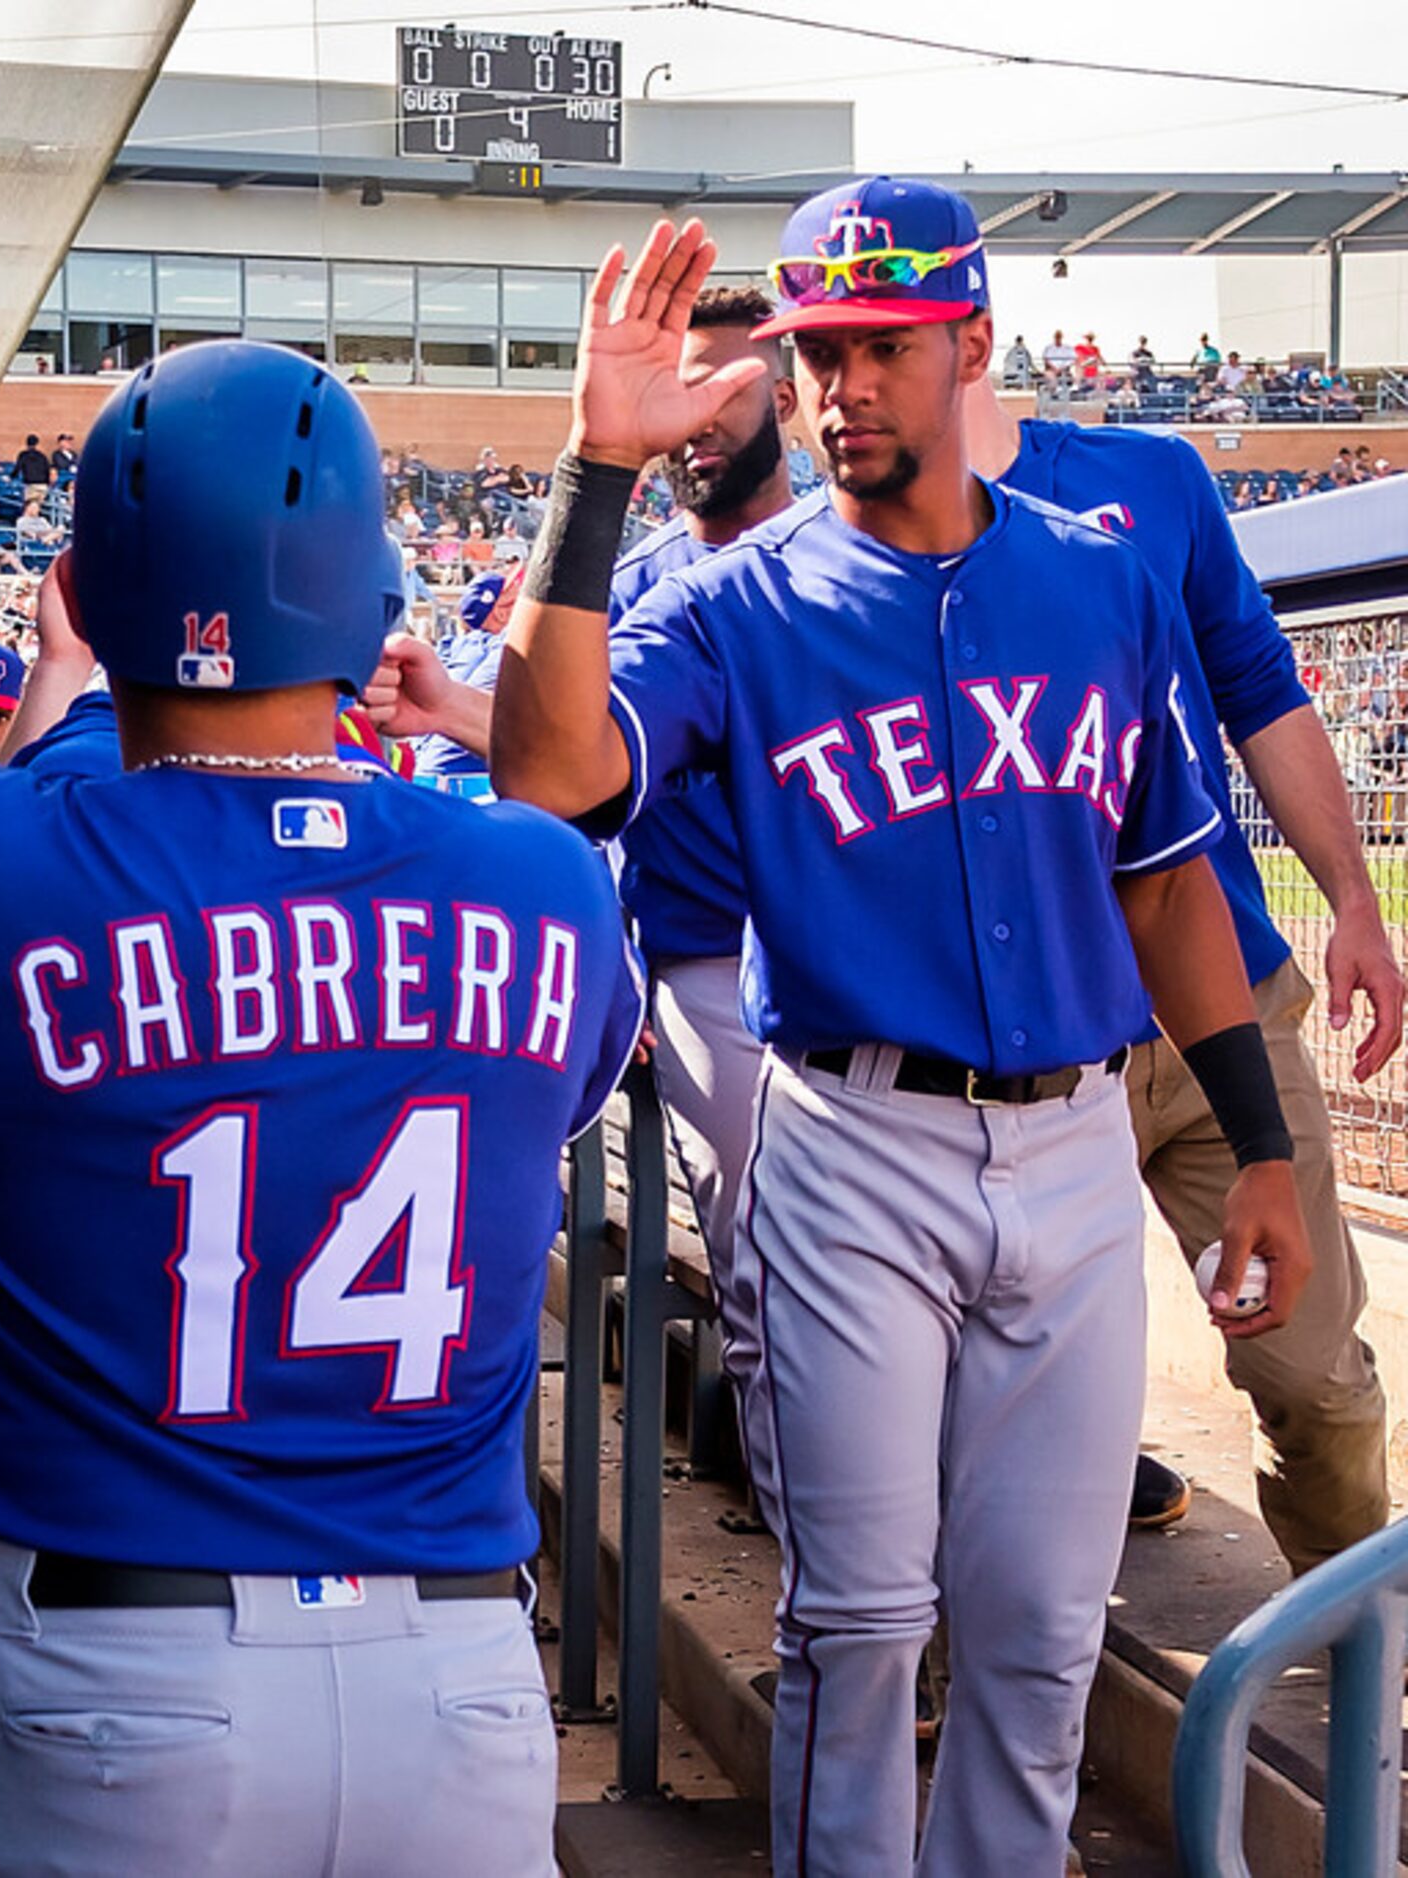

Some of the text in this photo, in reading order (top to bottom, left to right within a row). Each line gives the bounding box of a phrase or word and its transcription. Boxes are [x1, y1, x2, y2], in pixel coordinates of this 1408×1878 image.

[403, 29, 443, 47] BALL
[454, 33, 509, 52] STRIKE
[528, 35, 561, 55] OUT
[413, 47, 615, 95] 0 0 0 30
[403, 89, 620, 122] GUEST HOME
[434, 114, 455, 152] 0
[507, 106, 530, 139] 4
[183, 611, 231, 656] 14
[12, 898, 579, 1092] CABRERA
[150, 1094, 475, 1424] 14
